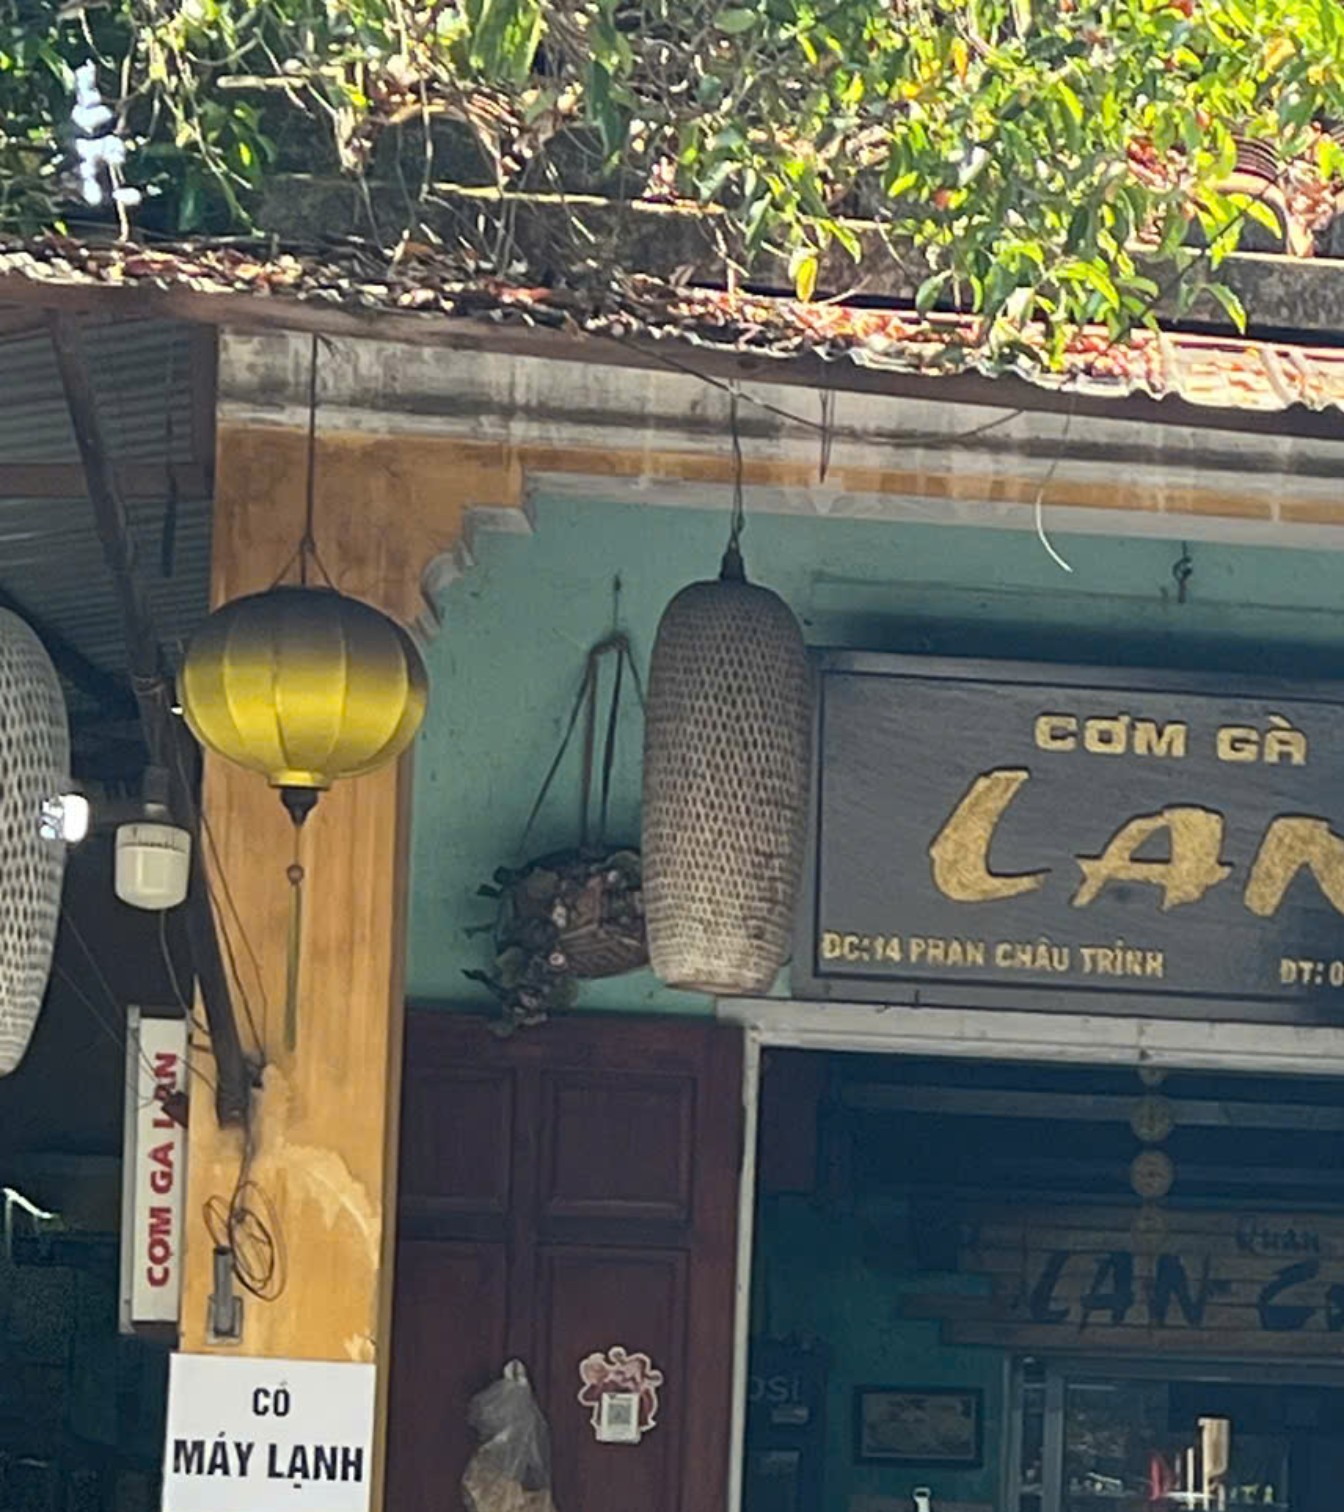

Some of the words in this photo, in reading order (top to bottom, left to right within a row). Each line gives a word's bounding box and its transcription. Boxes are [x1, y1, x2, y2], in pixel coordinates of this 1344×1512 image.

[1035, 712, 1187, 757] CƠM
[1217, 712, 1306, 766] GÀ
[910, 938, 984, 966] PHAN
[995, 937, 1070, 972] CHÂU
[173, 1431, 254, 1477] MÁY
[268, 1443, 363, 1489] LẠNH
